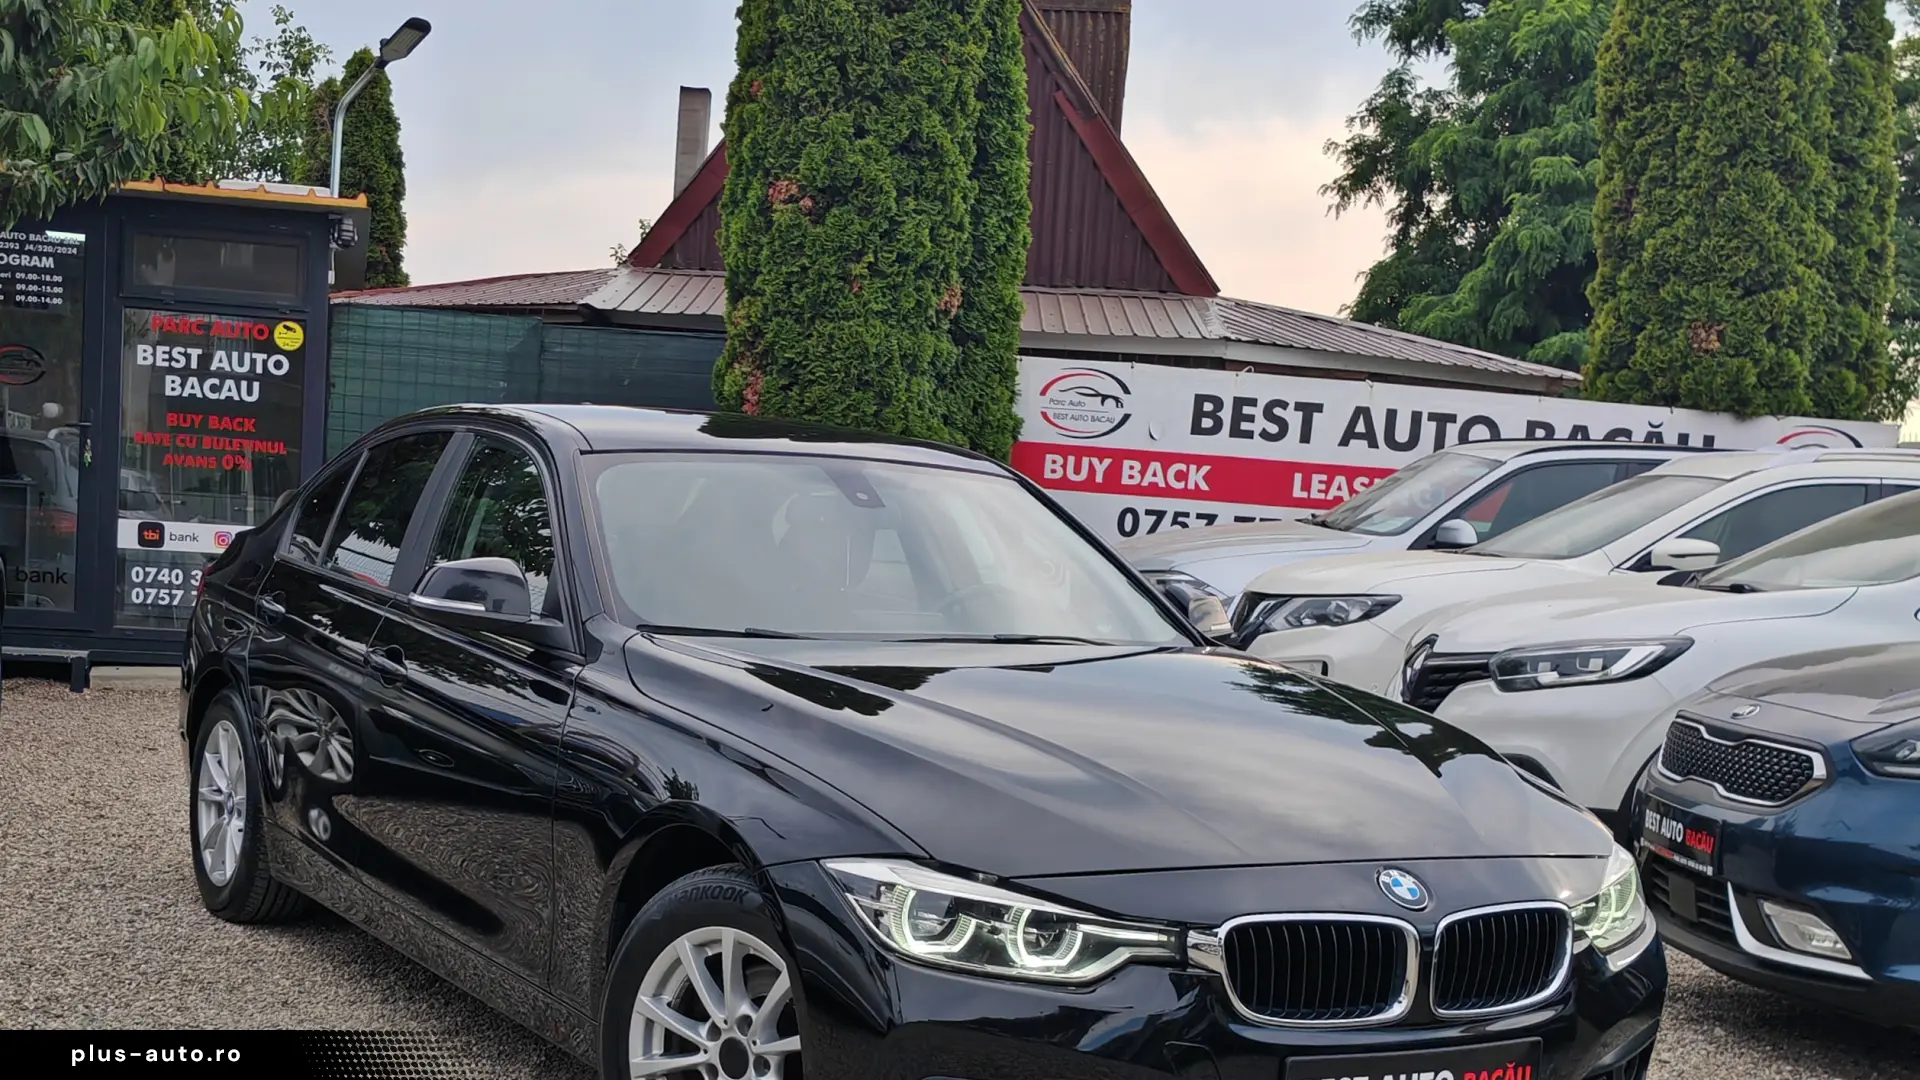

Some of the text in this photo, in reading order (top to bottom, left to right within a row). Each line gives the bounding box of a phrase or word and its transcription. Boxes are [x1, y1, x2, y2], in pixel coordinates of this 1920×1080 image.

[15, 272, 63, 282] 09.00-18.00
[151, 315, 270, 341] PARC AUTO
[136, 344, 290, 376] BEST AUTO
[165, 374, 260, 403] BACAU
[1048, 397, 1086, 408] Parc Auto
[166, 412, 256, 433] BUY BACK
[1053, 412, 1116, 425] BEST AUTO BACAU
[1190, 393, 1324, 444] BEST
[1337, 405, 1501, 453] AUTO
[176, 433, 197, 448] CU
[162, 452, 252, 472] AVANS 0%
[1043, 453, 1113, 484] BUY
[1121, 459, 1212, 491] BACK
[143, 529, 199, 543] tbi bank
[15, 565, 68, 585] bank
[131, 566, 184, 585] 0740
[131, 587, 184, 606] 0757
[1645, 808, 1661, 833] BEST
[1660, 816, 1684, 843] AUTO
